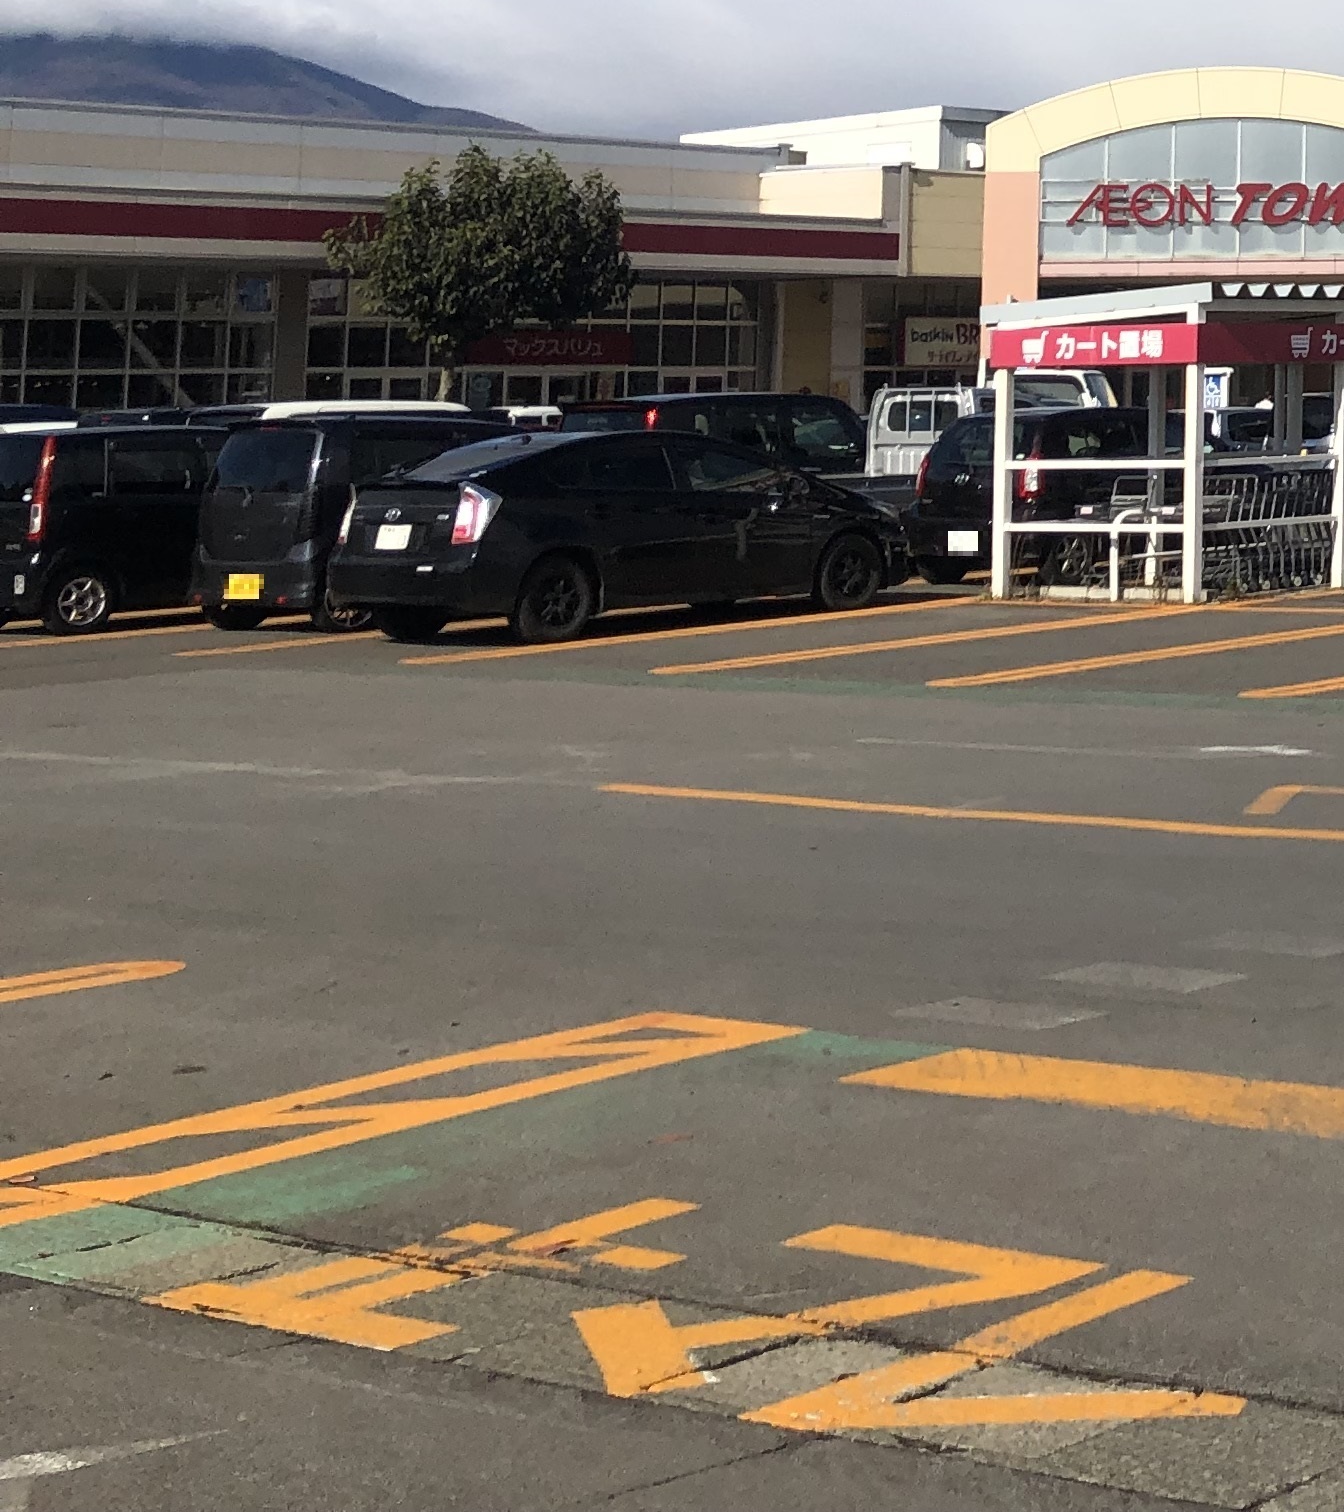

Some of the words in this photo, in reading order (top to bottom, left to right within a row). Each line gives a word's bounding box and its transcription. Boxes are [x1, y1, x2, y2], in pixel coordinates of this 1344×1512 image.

[1056, 329, 1164, 359] カート置場
